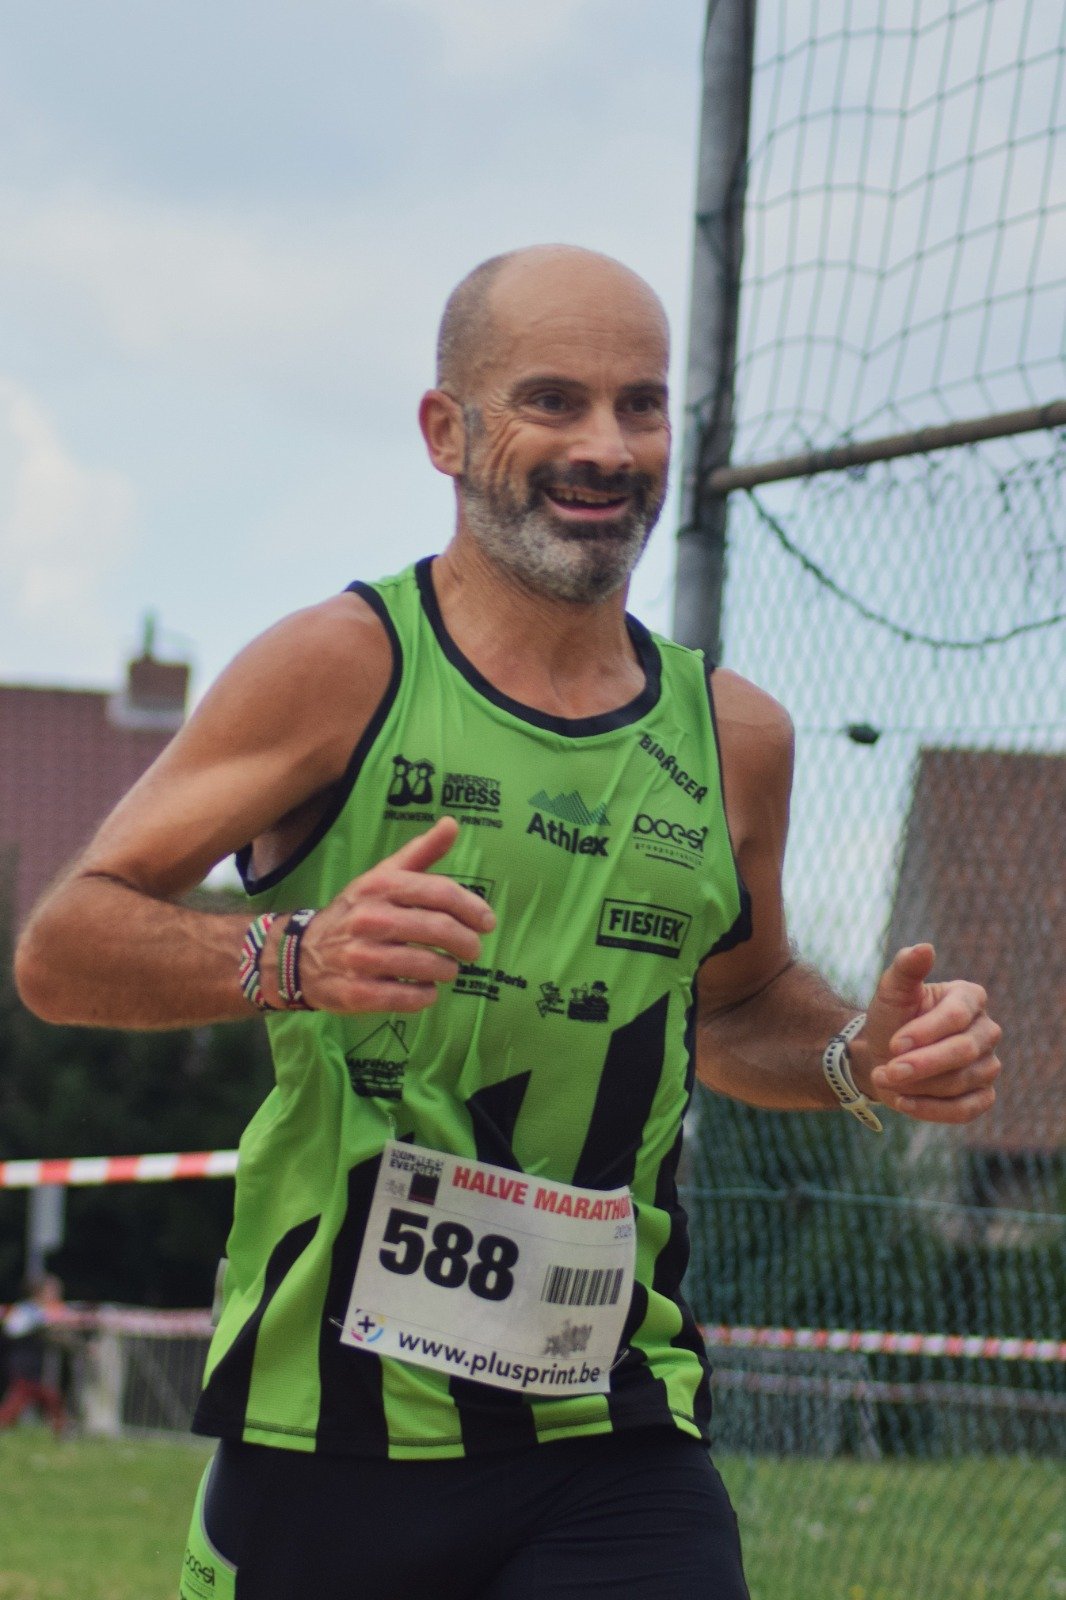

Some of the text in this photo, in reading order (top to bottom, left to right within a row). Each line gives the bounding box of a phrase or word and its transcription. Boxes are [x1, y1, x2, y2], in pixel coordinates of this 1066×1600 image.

[441, 782, 501, 807] press
[525, 811, 610, 858] Athlex
[608, 907, 685, 943] FIESIEK
[451, 1165, 530, 1206] HALVE
[378, 1207, 520, 1302] 588
[397, 1331, 601, 1388] www.plusprint.be
